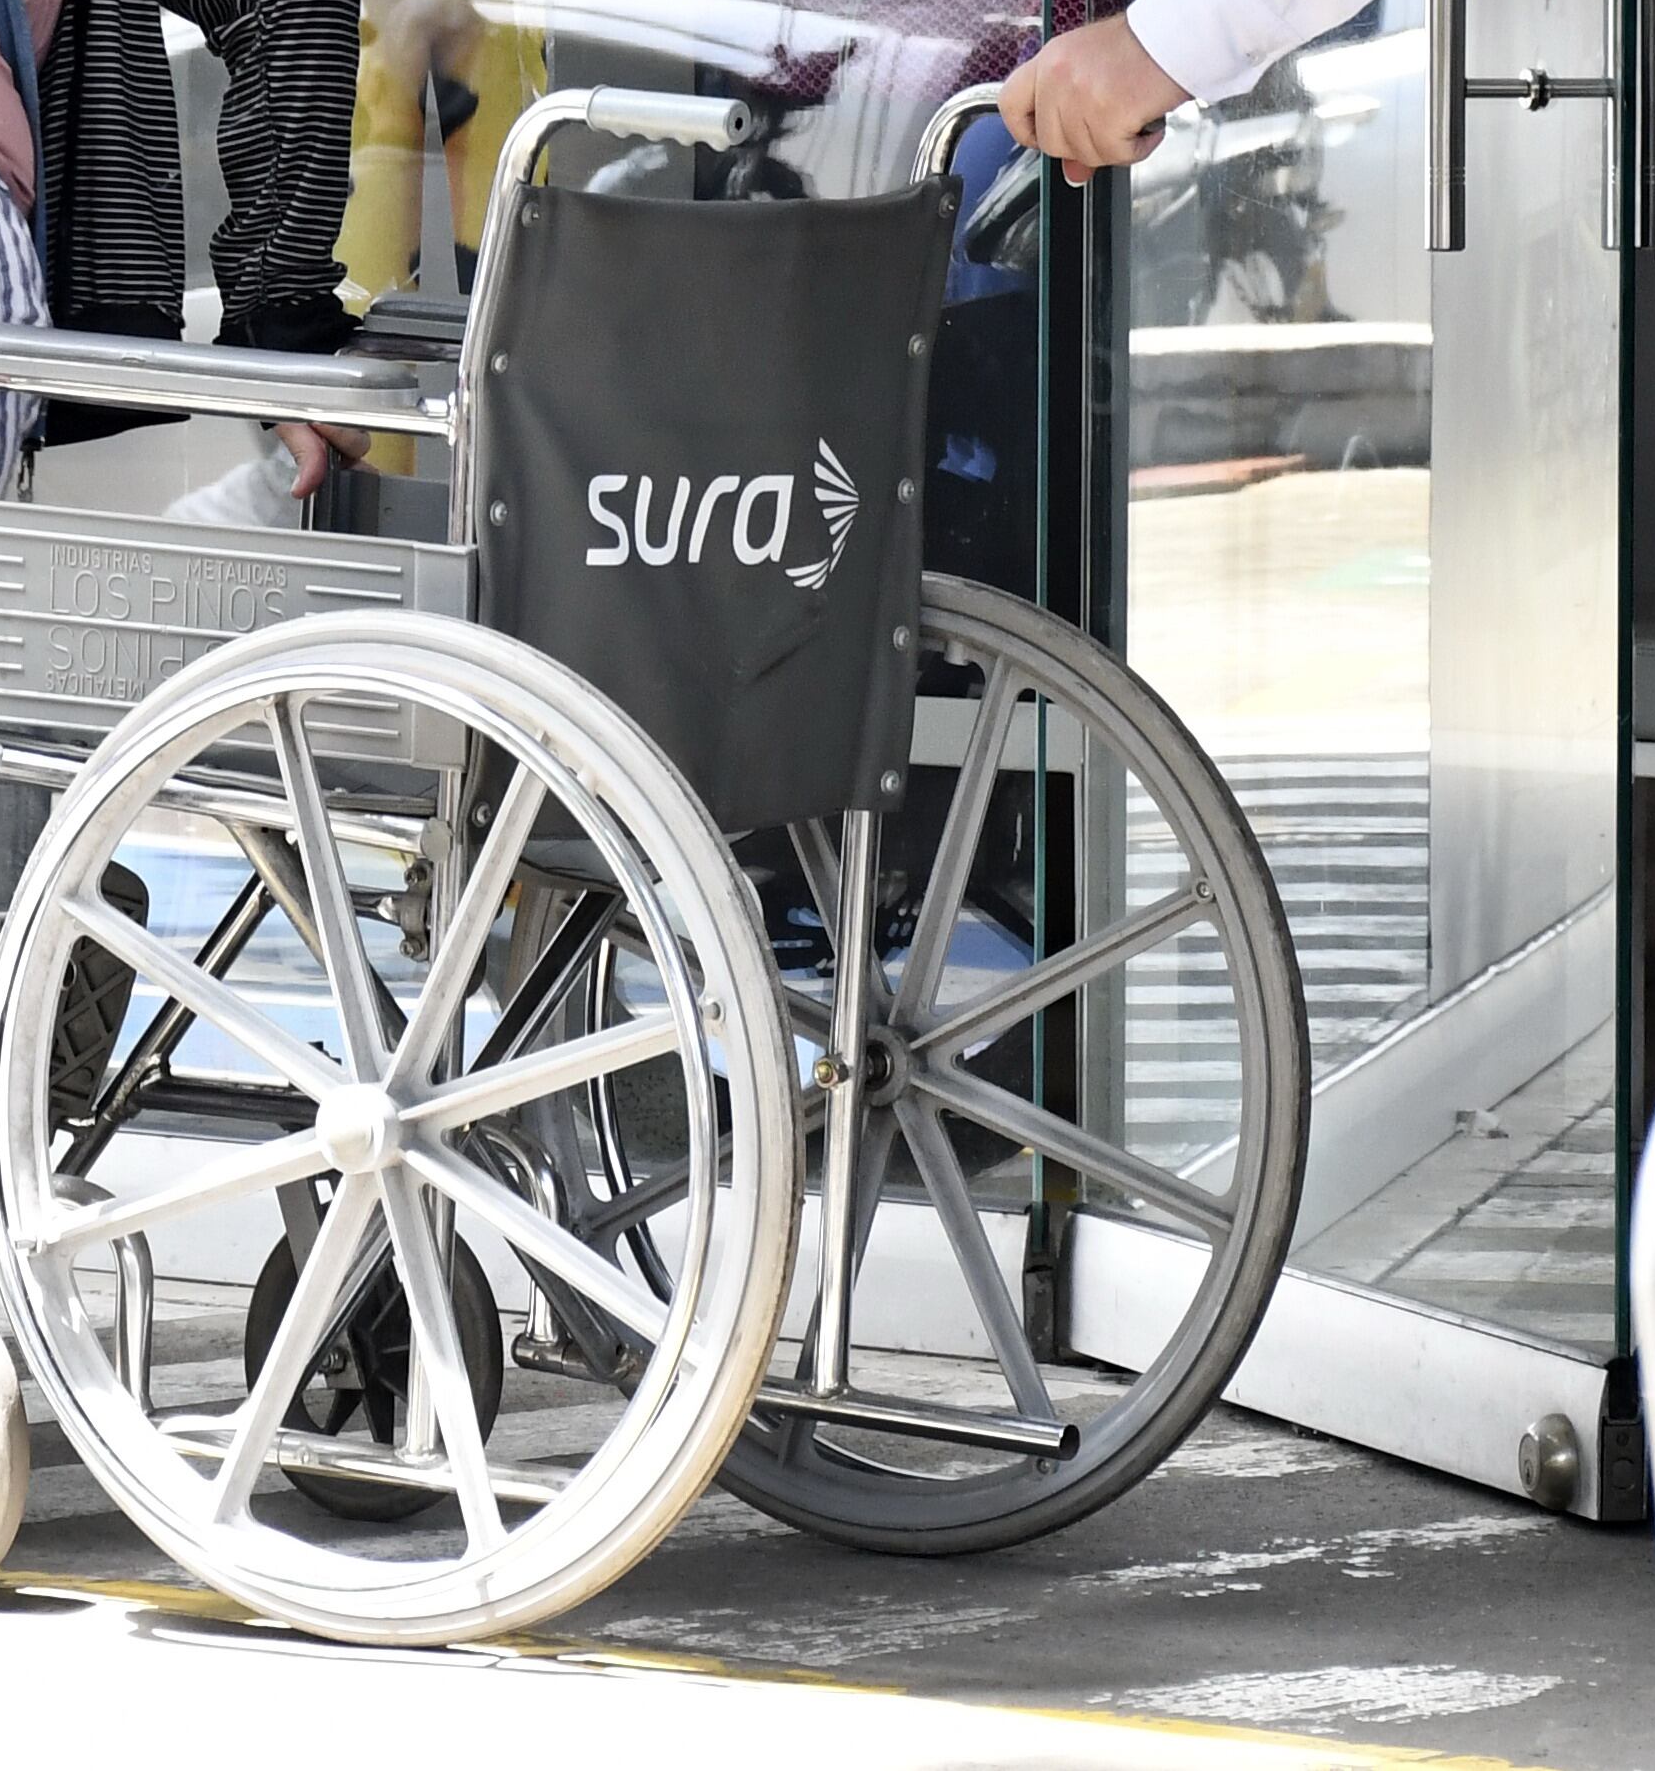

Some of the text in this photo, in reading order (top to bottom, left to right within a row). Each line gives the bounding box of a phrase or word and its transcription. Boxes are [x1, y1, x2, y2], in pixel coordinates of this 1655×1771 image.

[586, 475, 795, 566] sura
[50, 544, 288, 588] INDUSTRIAS METALICAS
[50, 567, 287, 632] LOS PINOS
